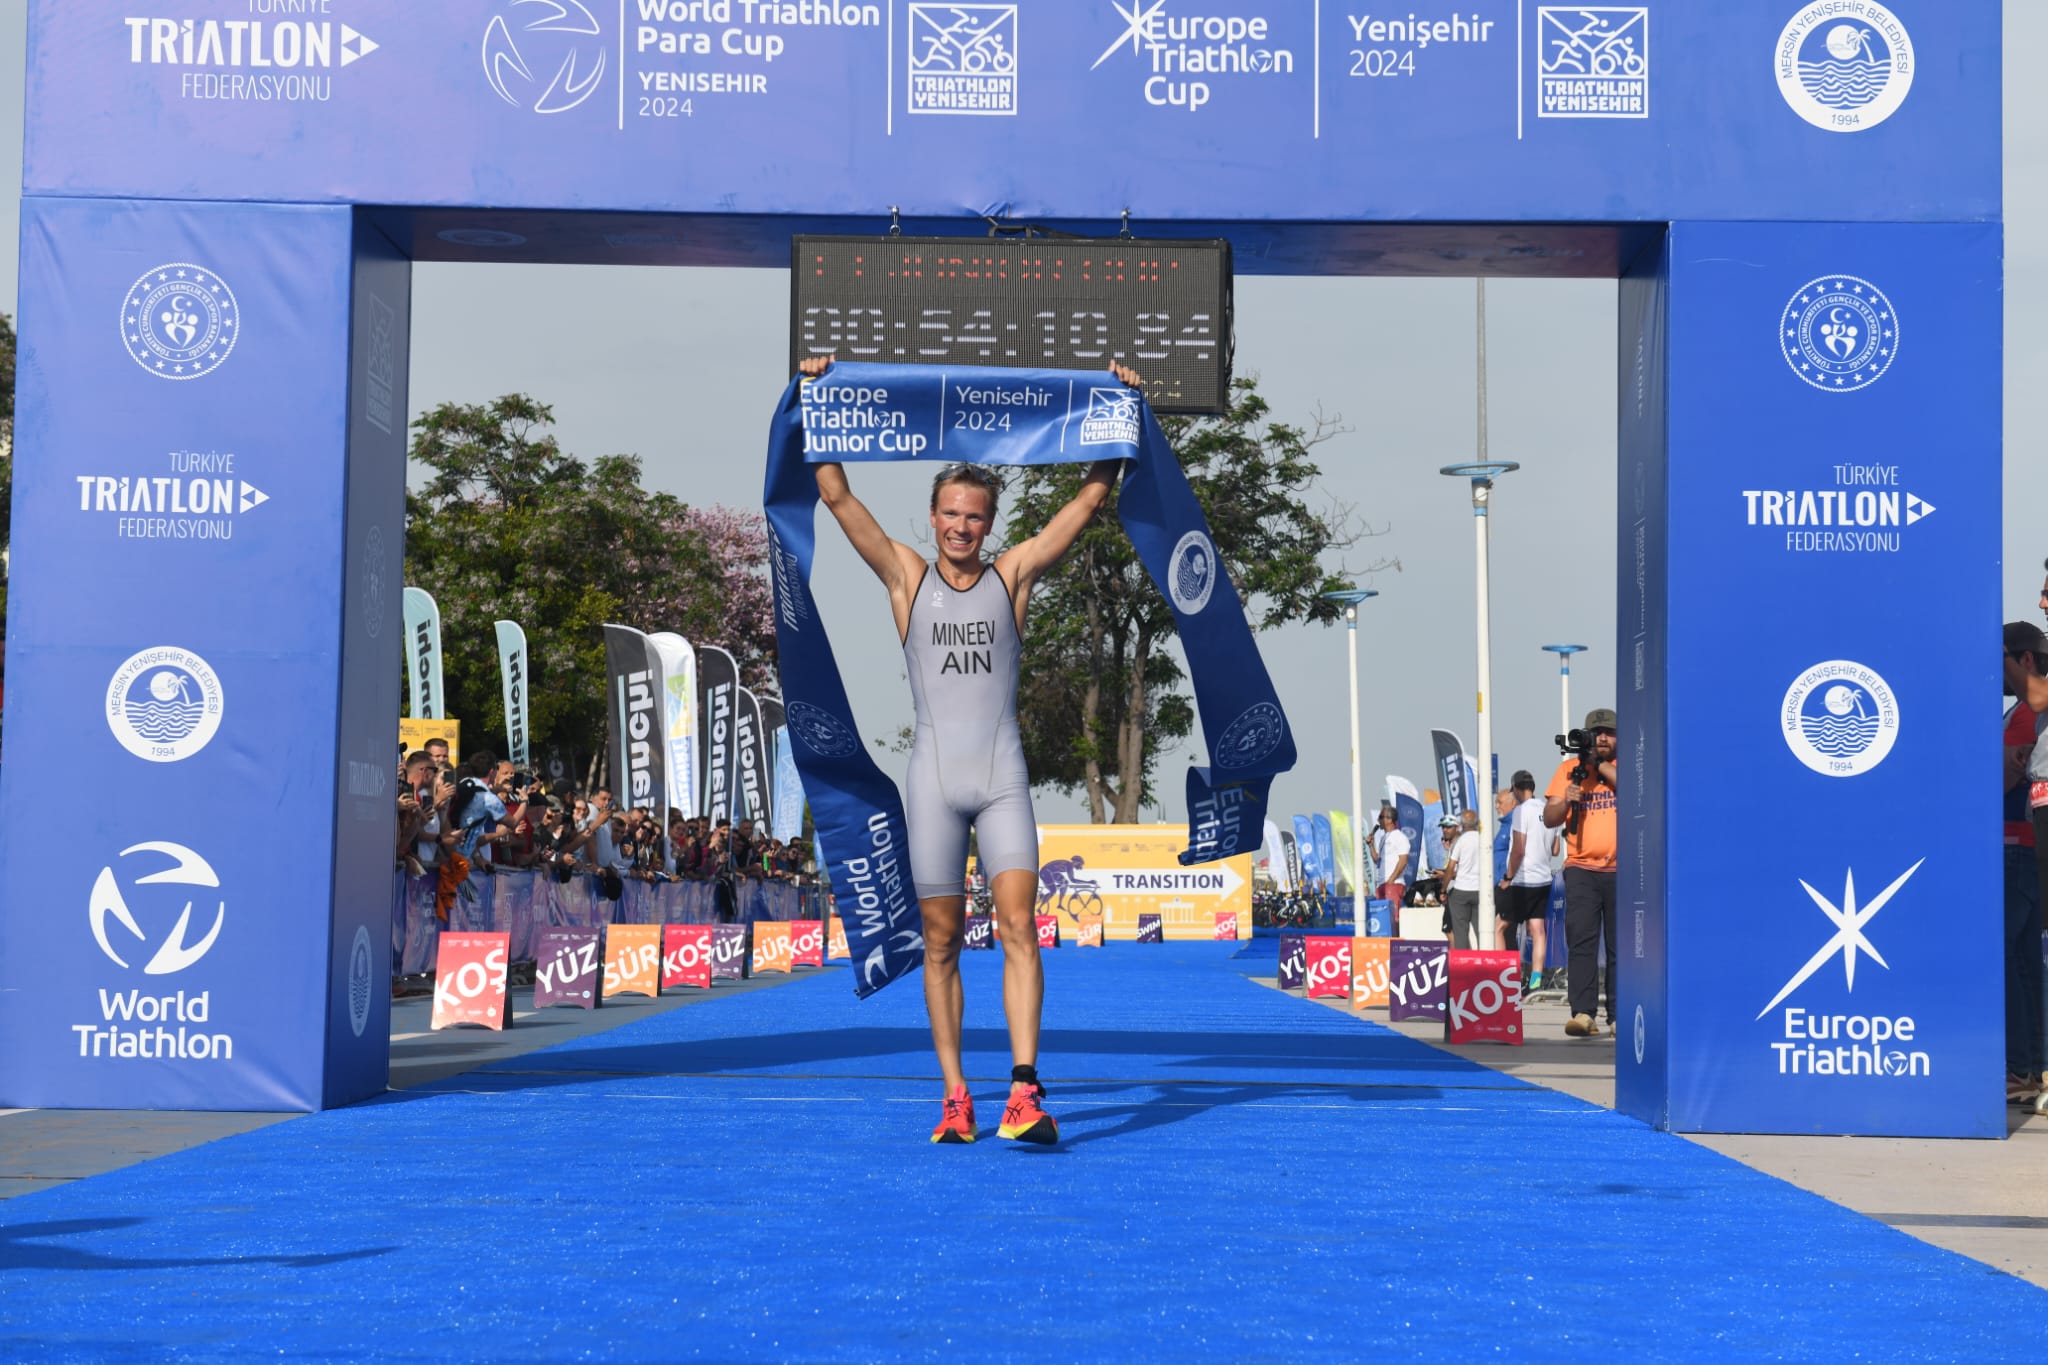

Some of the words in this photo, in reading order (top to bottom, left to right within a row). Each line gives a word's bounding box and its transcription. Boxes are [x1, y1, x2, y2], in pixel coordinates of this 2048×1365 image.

[637, 0, 731, 23] World
[737, 0, 880, 26] Triathlon
[1146, 11, 1268, 43] Europe
[1348, 13, 1494, 48] Yenişehir
[638, 26, 711, 53] Para
[721, 28, 785, 62] Cup
[1144, 43, 1294, 74] Triathlon
[1349, 49, 1416, 77] 2024
[182, 73, 331, 101] FEDERASYONU
[638, 71, 768, 94] YENISEHIR
[914, 76, 1012, 93] TRIATHLON
[1144, 76, 1211, 112] Cup
[1544, 80, 1643, 96] TRIATHLON
[639, 97, 694, 117] 2024
[914, 92, 1011, 109] YENISEHIR
[1544, 96, 1643, 112] YENISEHIR
[1831, 113, 1860, 126] 1994
[800, 382, 888, 407] Europe
[955, 386, 1054, 407] Yenisehir
[954, 410, 1012, 433] 2024
[803, 429, 875, 454] Junior
[879, 429, 928, 456] Cup
[169, 450, 235, 474] TÜRKİYE
[1833, 462, 1899, 486] TÜRKİYE
[118, 517, 233, 540] FEDERASYONU
[1786, 531, 1900, 552] FEDERASYONU
[931, 620, 996, 646] MINEEV
[940, 650, 993, 675] AIN
[151, 746, 176, 757] 1994
[1829, 761, 1853, 772] 1994
[867, 811, 907, 928] Triathlon
[1112, 874, 1224, 889] TRANSITION
[842, 857, 886, 937] World
[963, 921, 990, 945] YÜZ
[1037, 919, 1057, 942] OŞ
[1136, 919, 1161, 938] SWIM
[663, 935, 713, 979] KOŞ
[752, 935, 790, 969] SÜR
[789, 928, 823, 960] KOŞ
[828, 932, 849, 956] SÜ
[536, 941, 599, 994] YÜZ
[603, 943, 659, 990] SÜR
[1280, 947, 1305, 980] YÜ
[1306, 947, 1351, 990] KOŞ
[433, 947, 508, 1015] KOŞ
[1353, 958, 1390, 1003] SÜ
[1390, 953, 1449, 1006] YÜZ
[98, 988, 209, 1023] World
[1449, 966, 1524, 1031] KOŞ
[1785, 1008, 1916, 1045] Europe
[71, 1024, 233, 1060] Triathlon
[1770, 1042, 1931, 1077] Triathlon
